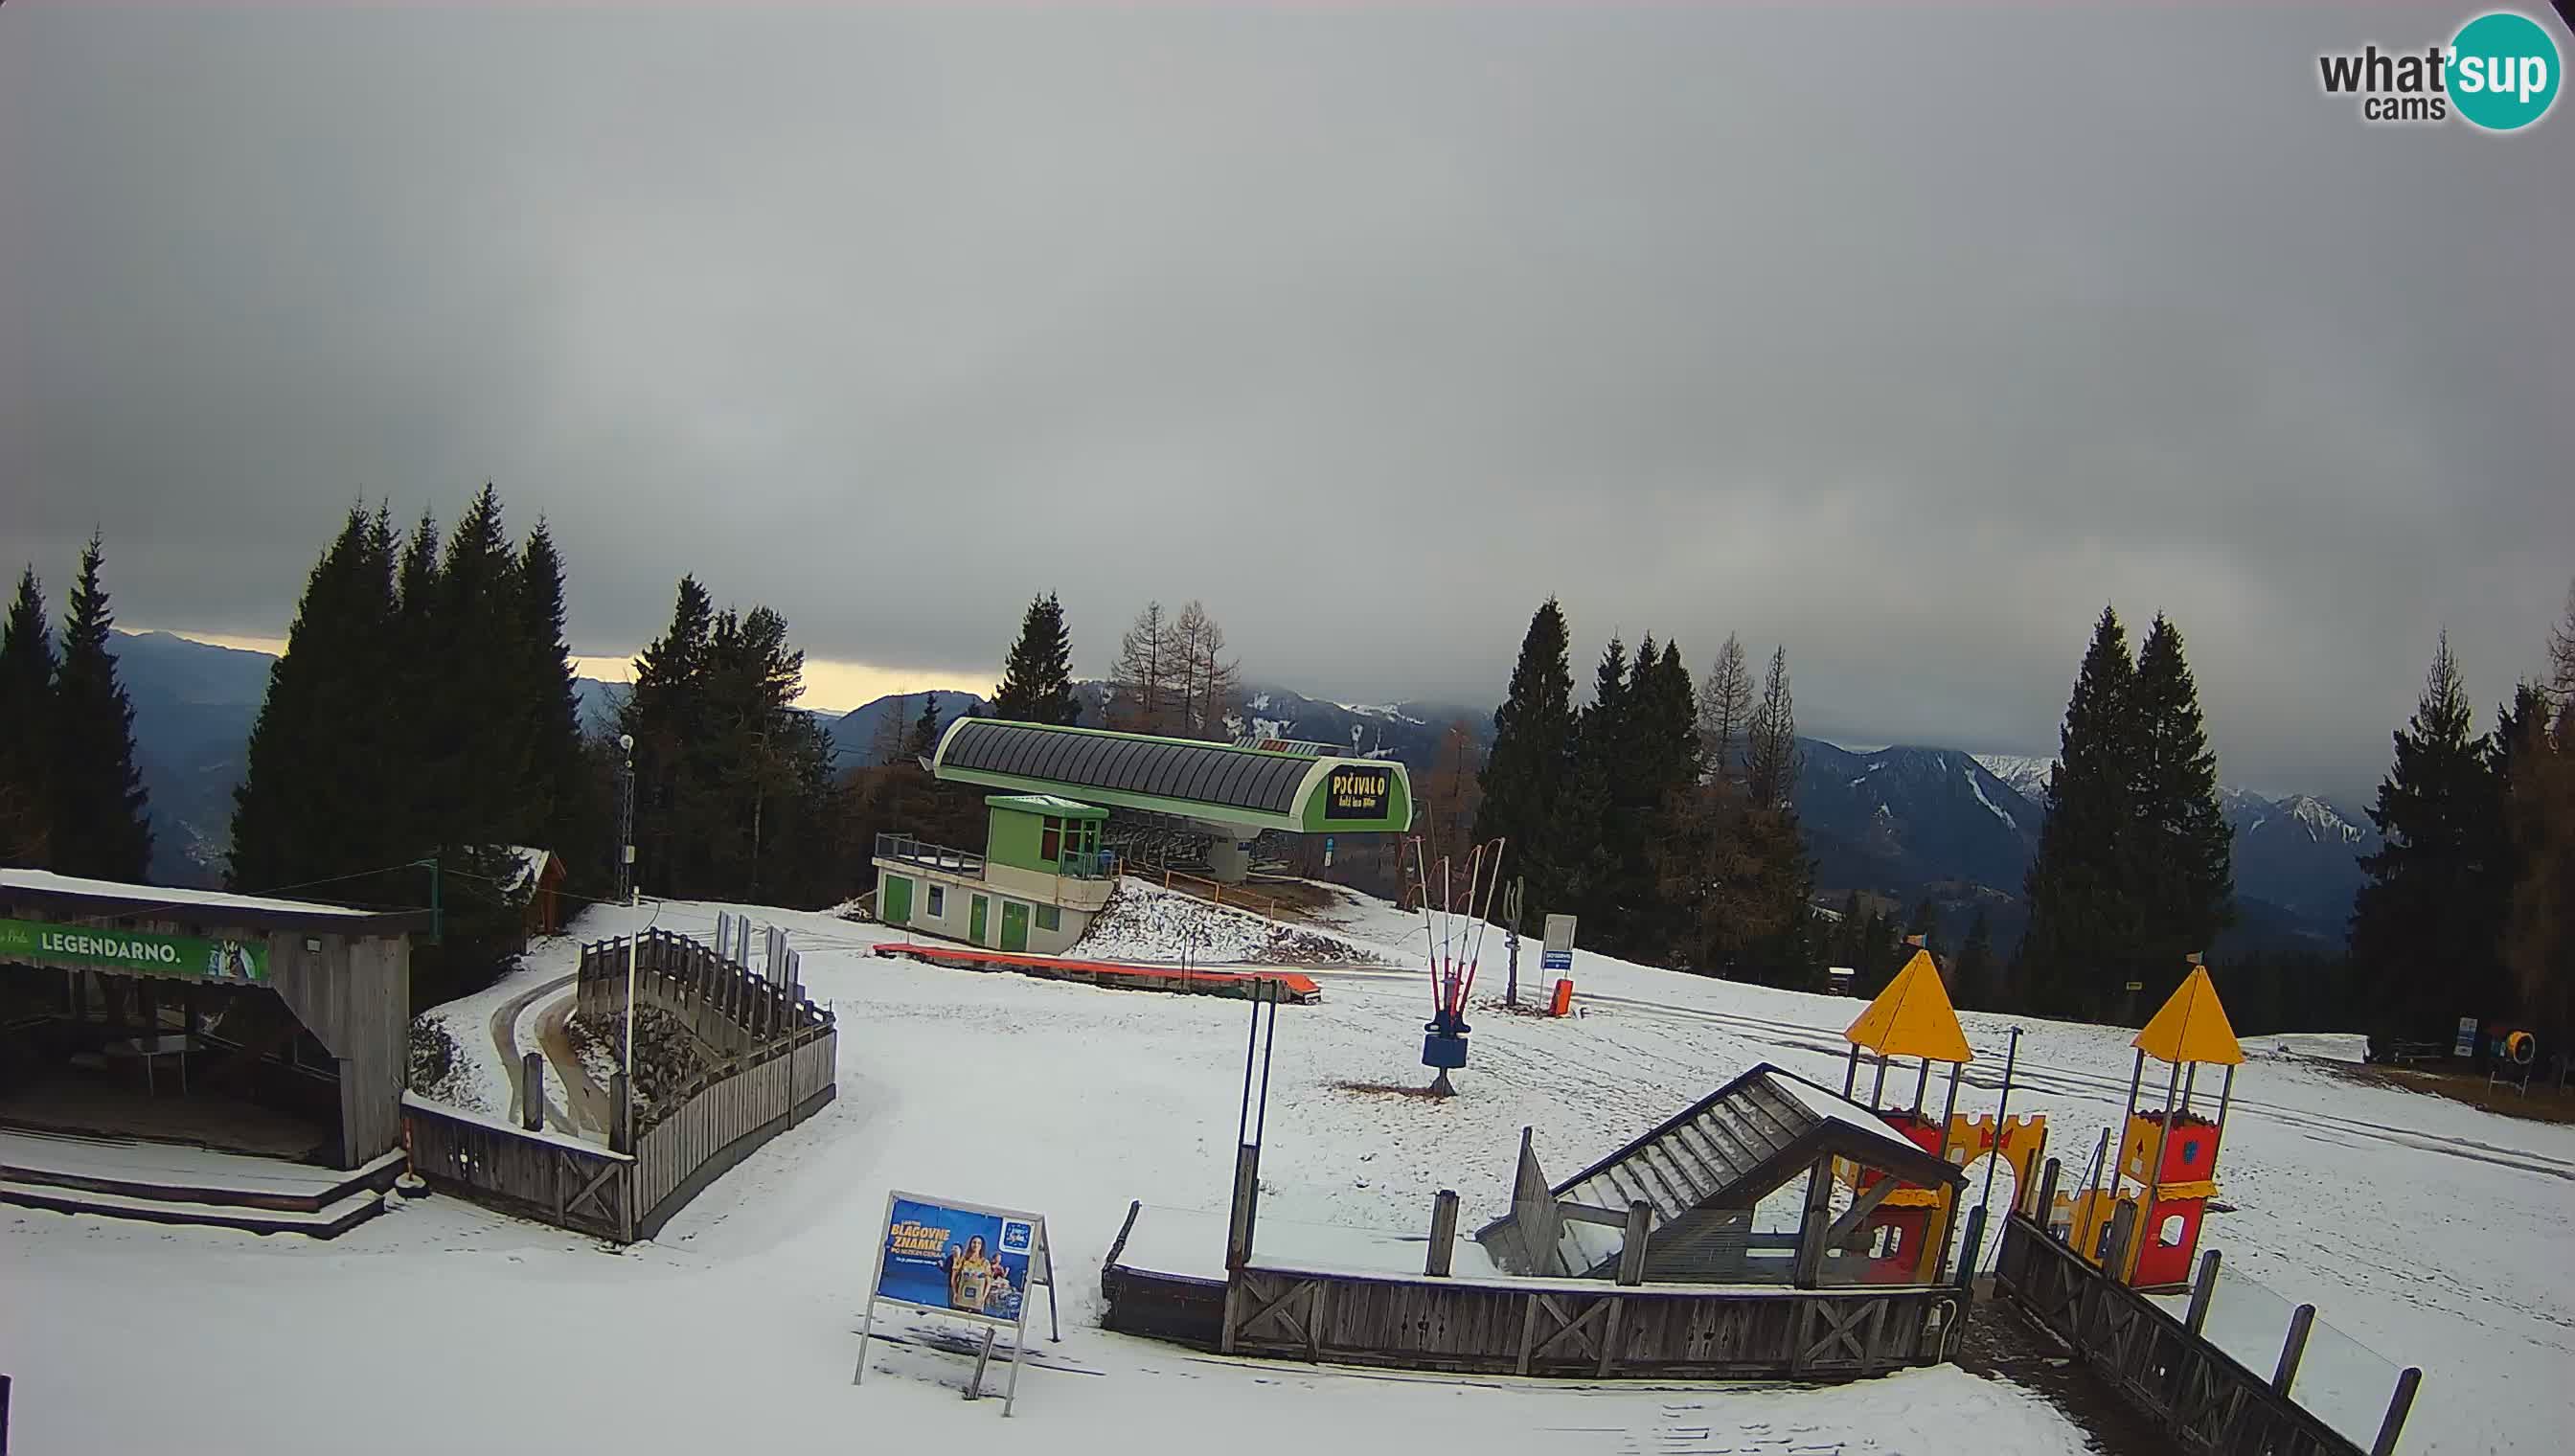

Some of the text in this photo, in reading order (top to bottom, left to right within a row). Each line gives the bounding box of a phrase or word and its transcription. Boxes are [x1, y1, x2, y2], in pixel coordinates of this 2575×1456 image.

[41, 932, 181, 964] LEGENDARNO.
[891, 1223, 951, 1241] BLAGOVNE
[893, 1236, 944, 1252] ZNAMKE
